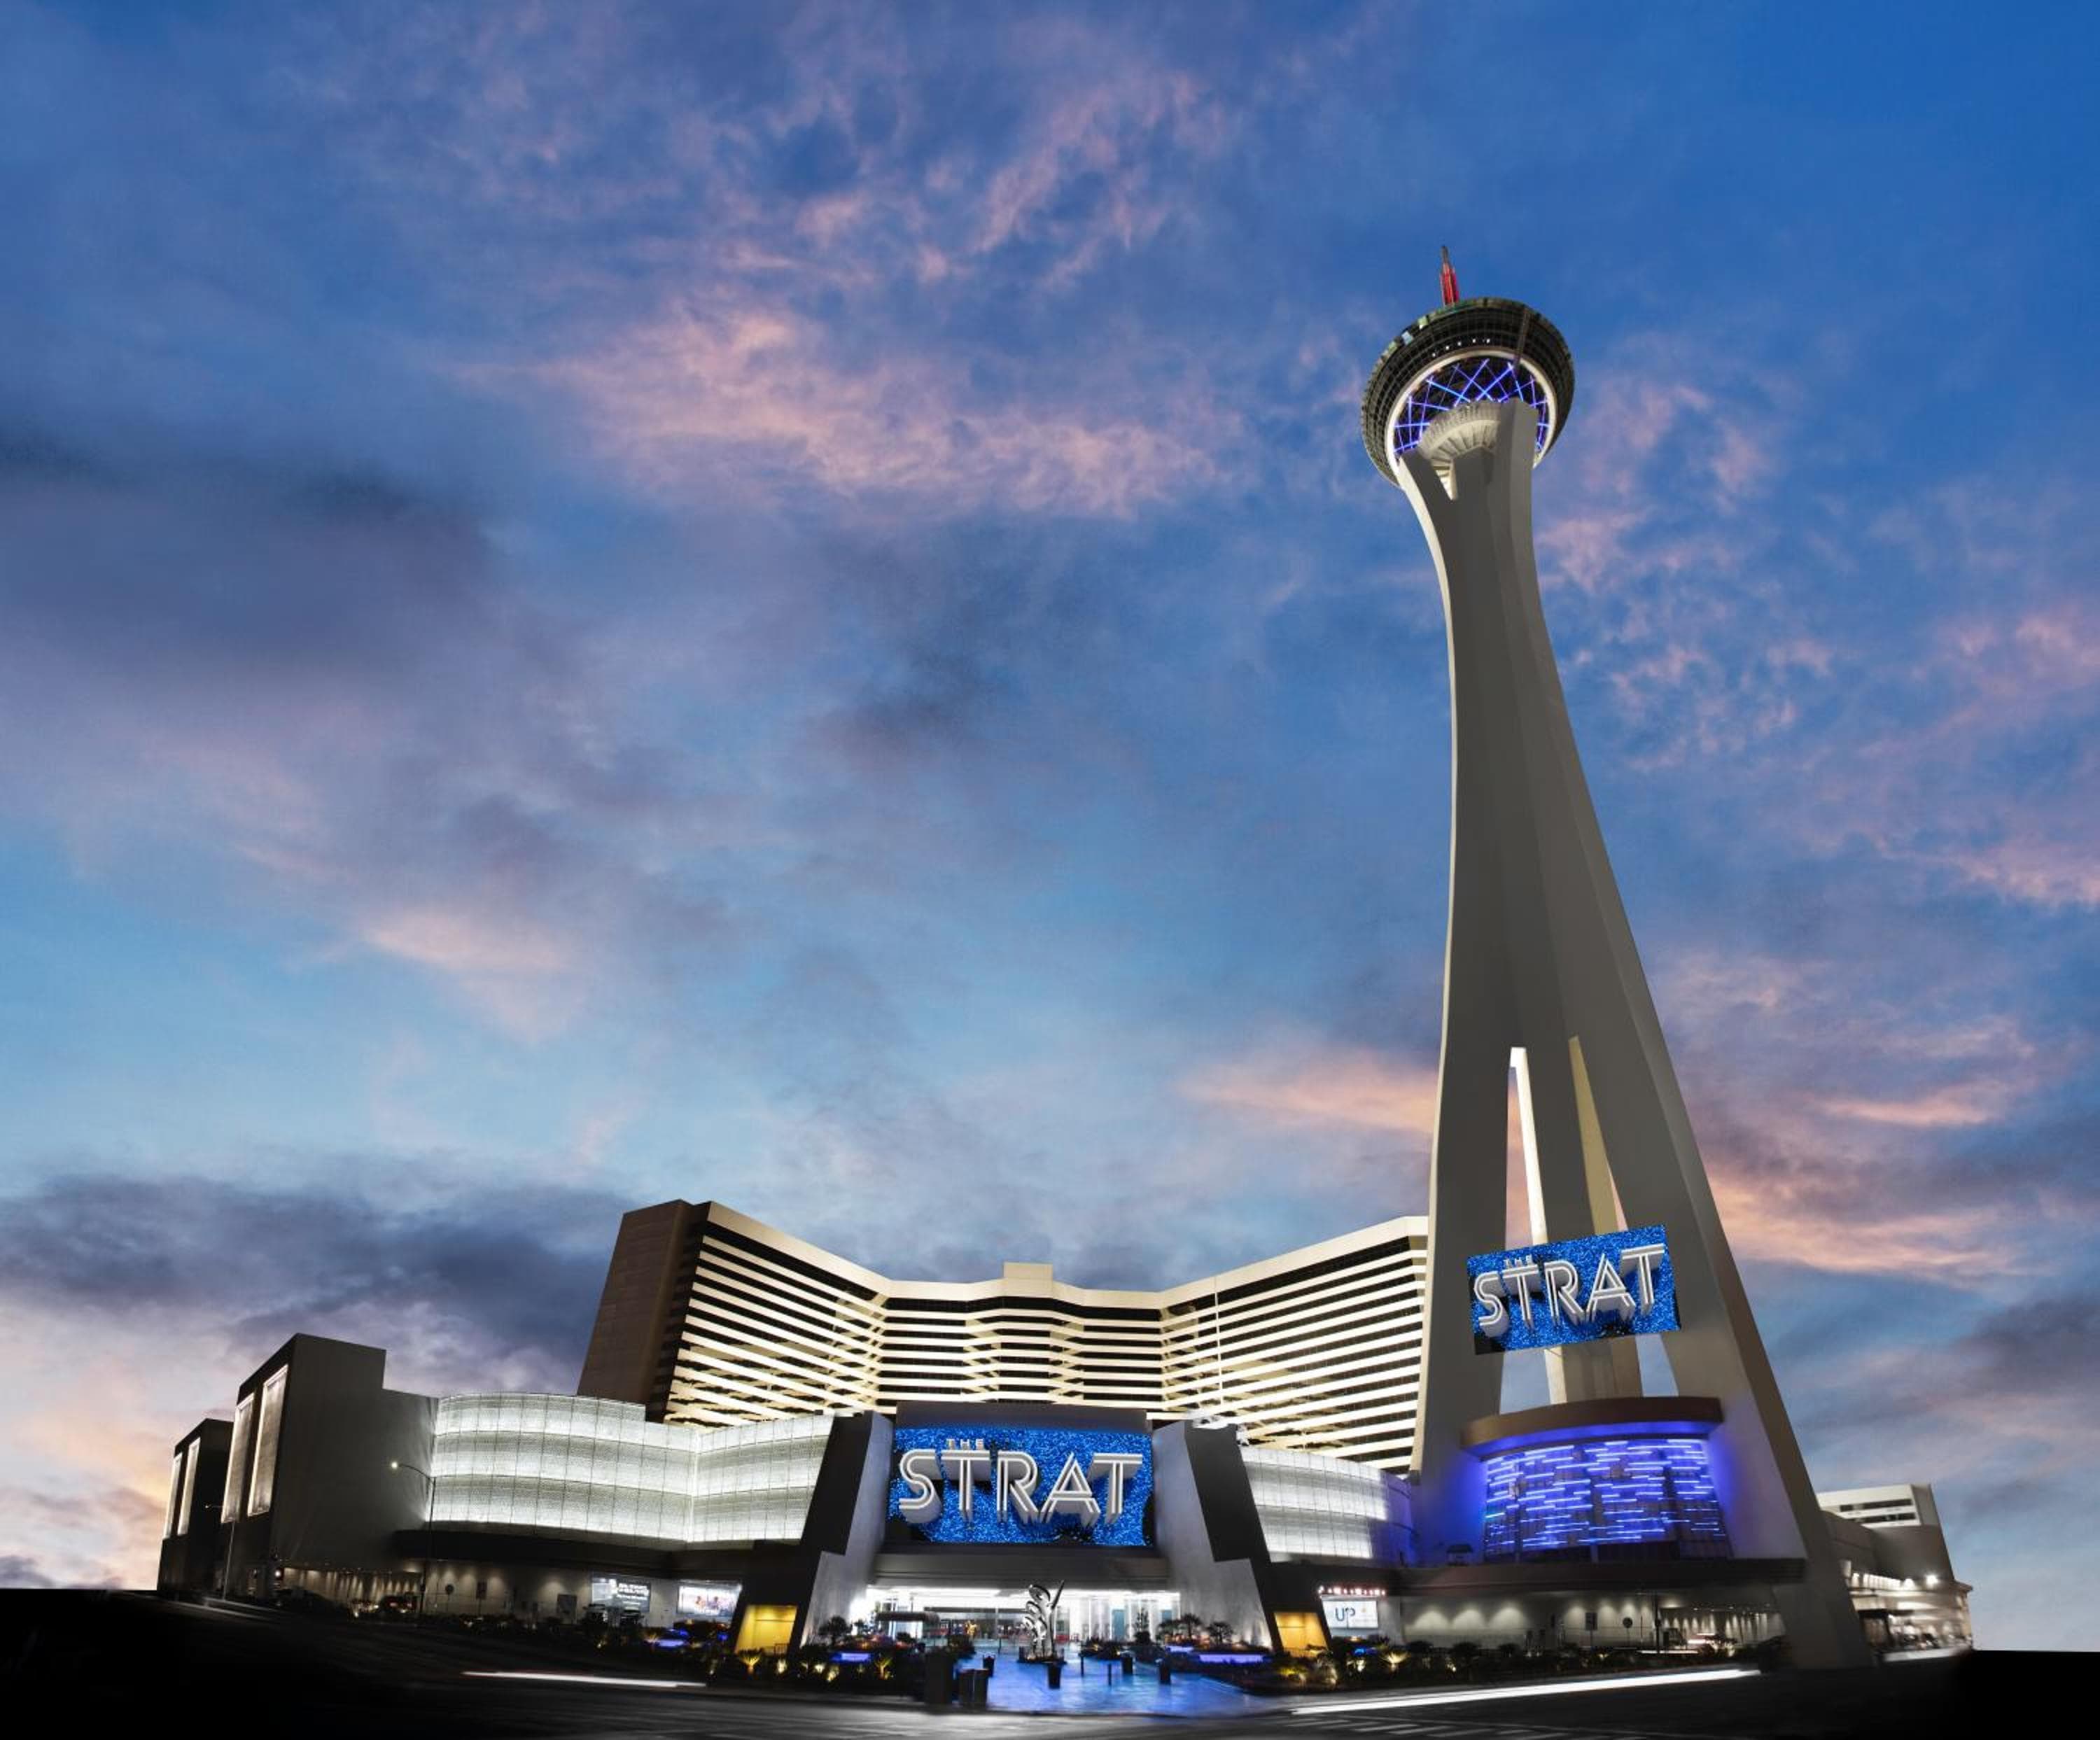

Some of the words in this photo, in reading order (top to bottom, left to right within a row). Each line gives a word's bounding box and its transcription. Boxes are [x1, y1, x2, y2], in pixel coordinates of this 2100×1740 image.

[1502, 1254, 1533, 1268] THE
[1474, 1243, 1665, 1331] STRAT
[945, 1438, 984, 1450] THE
[898, 1449, 1144, 1526] STRAT
